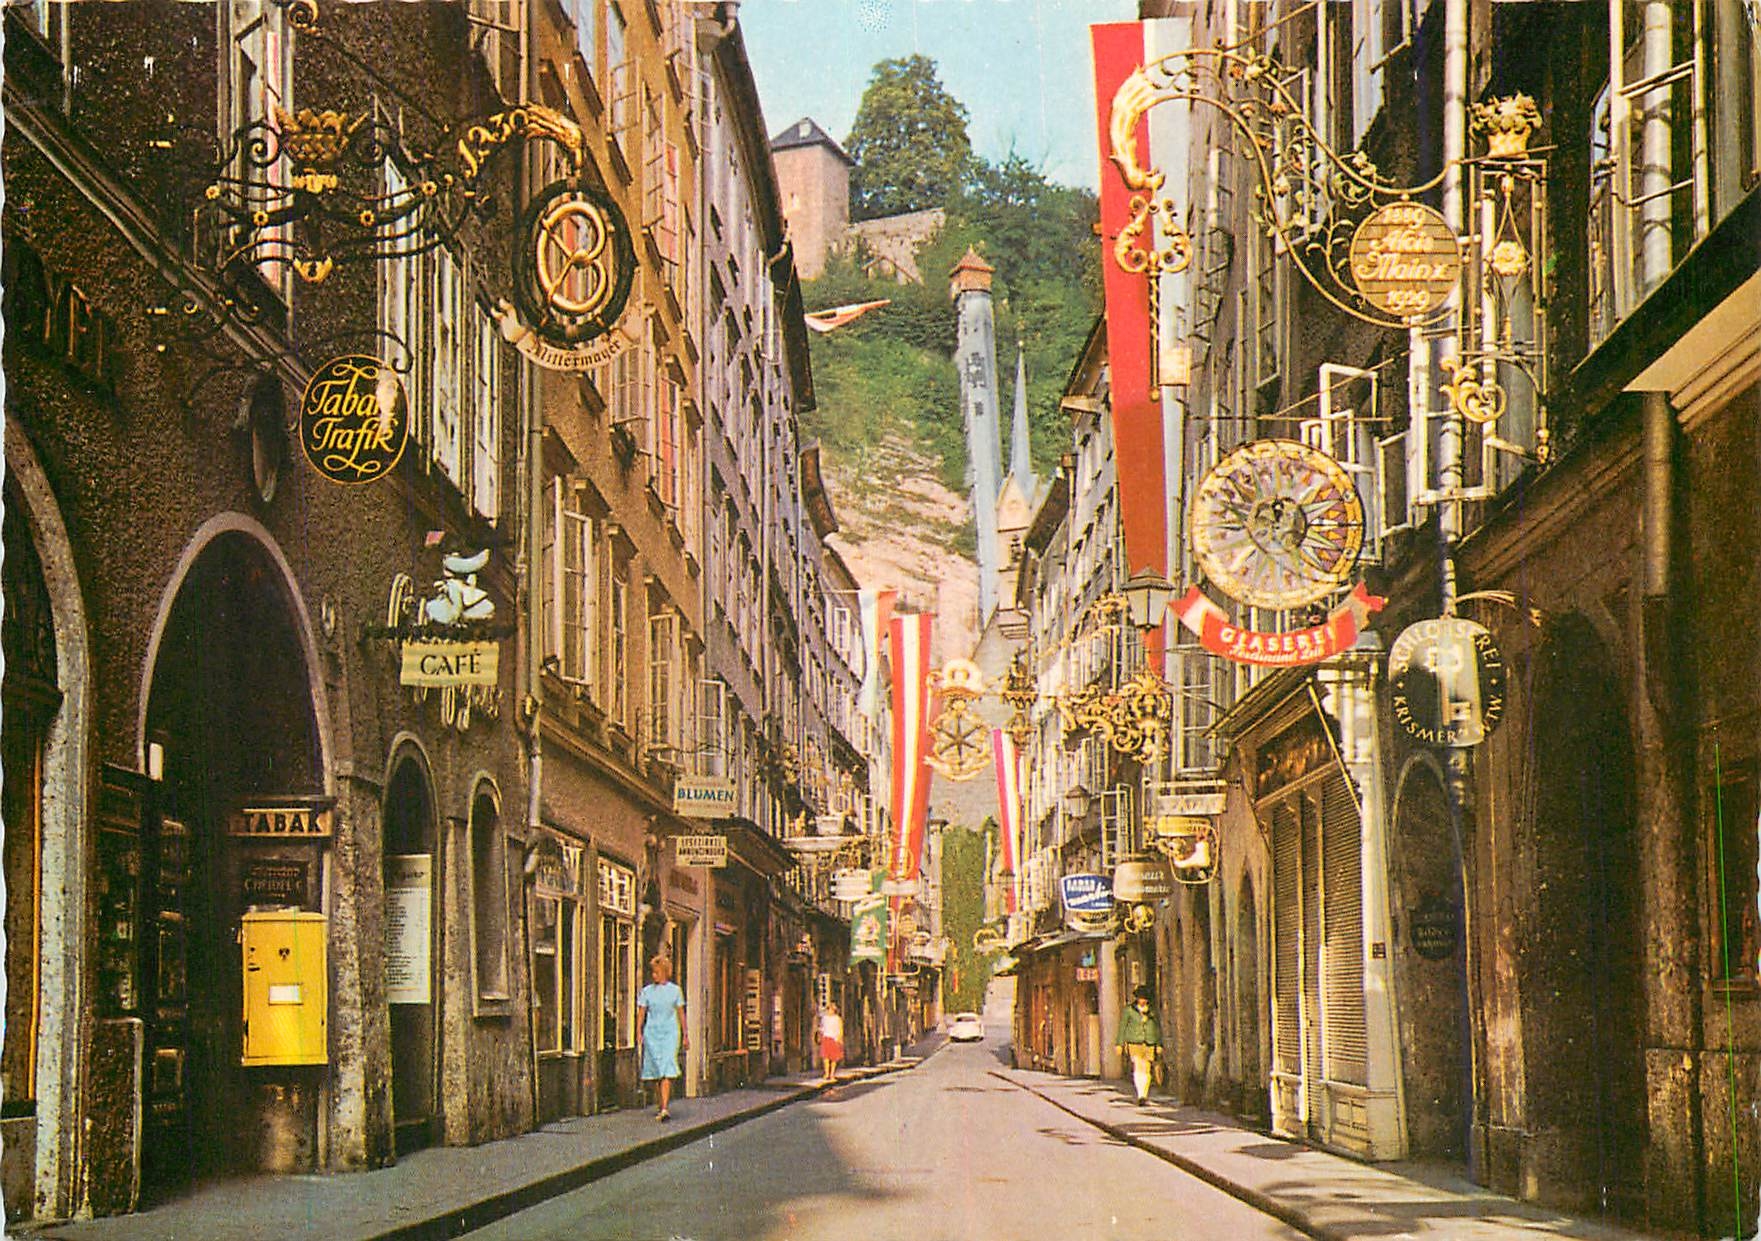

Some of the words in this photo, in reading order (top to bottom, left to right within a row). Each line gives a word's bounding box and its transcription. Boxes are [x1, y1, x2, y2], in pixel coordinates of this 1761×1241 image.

[310, 416, 398, 463] Trafik
[1220, 625, 1336, 652] GLASEREI
[420, 648, 481, 676] CAFÉ
[677, 787, 734, 802] BLUMEN
[241, 811, 324, 834] TABAK
